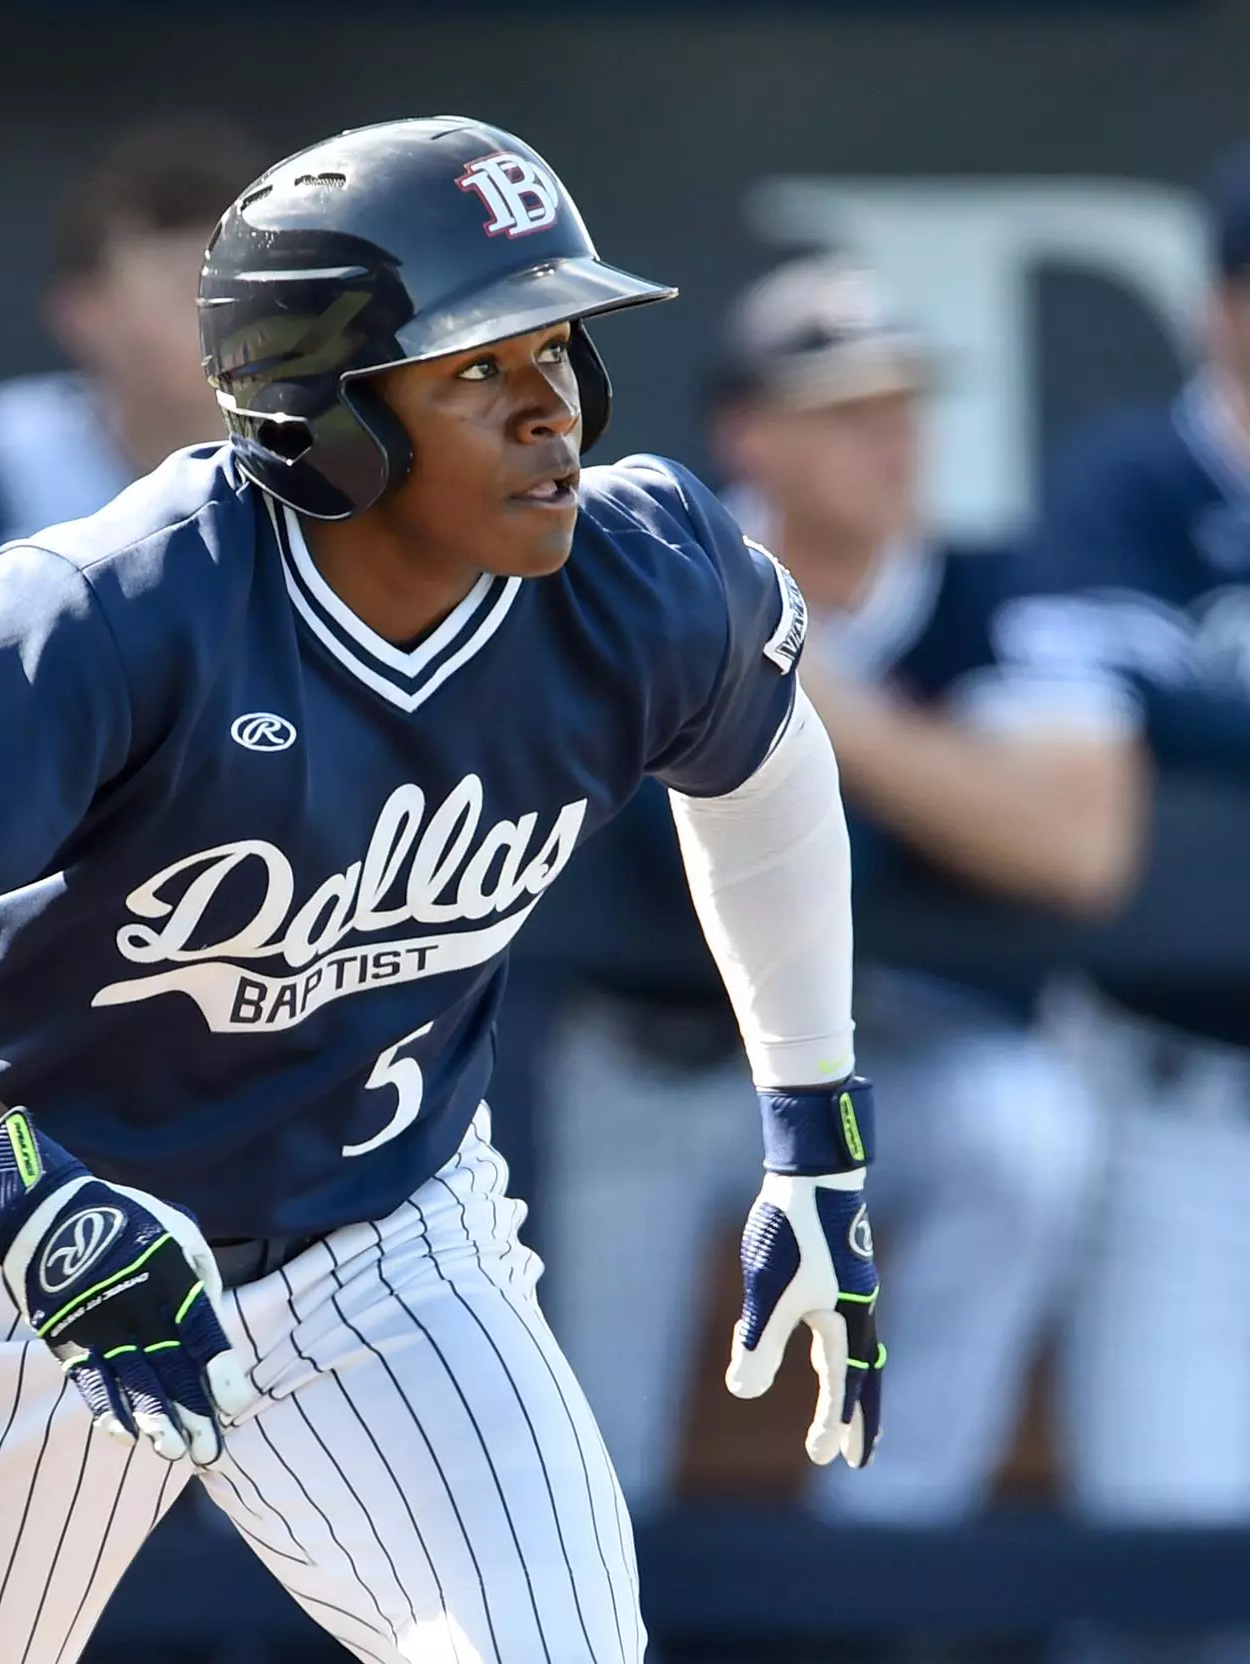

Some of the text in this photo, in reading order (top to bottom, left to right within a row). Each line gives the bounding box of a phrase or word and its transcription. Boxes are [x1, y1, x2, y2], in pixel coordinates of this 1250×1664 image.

[116, 773, 588, 968] Dallas
[229, 944, 440, 1025] BAPTIST
[341, 1020, 435, 1157] 5
